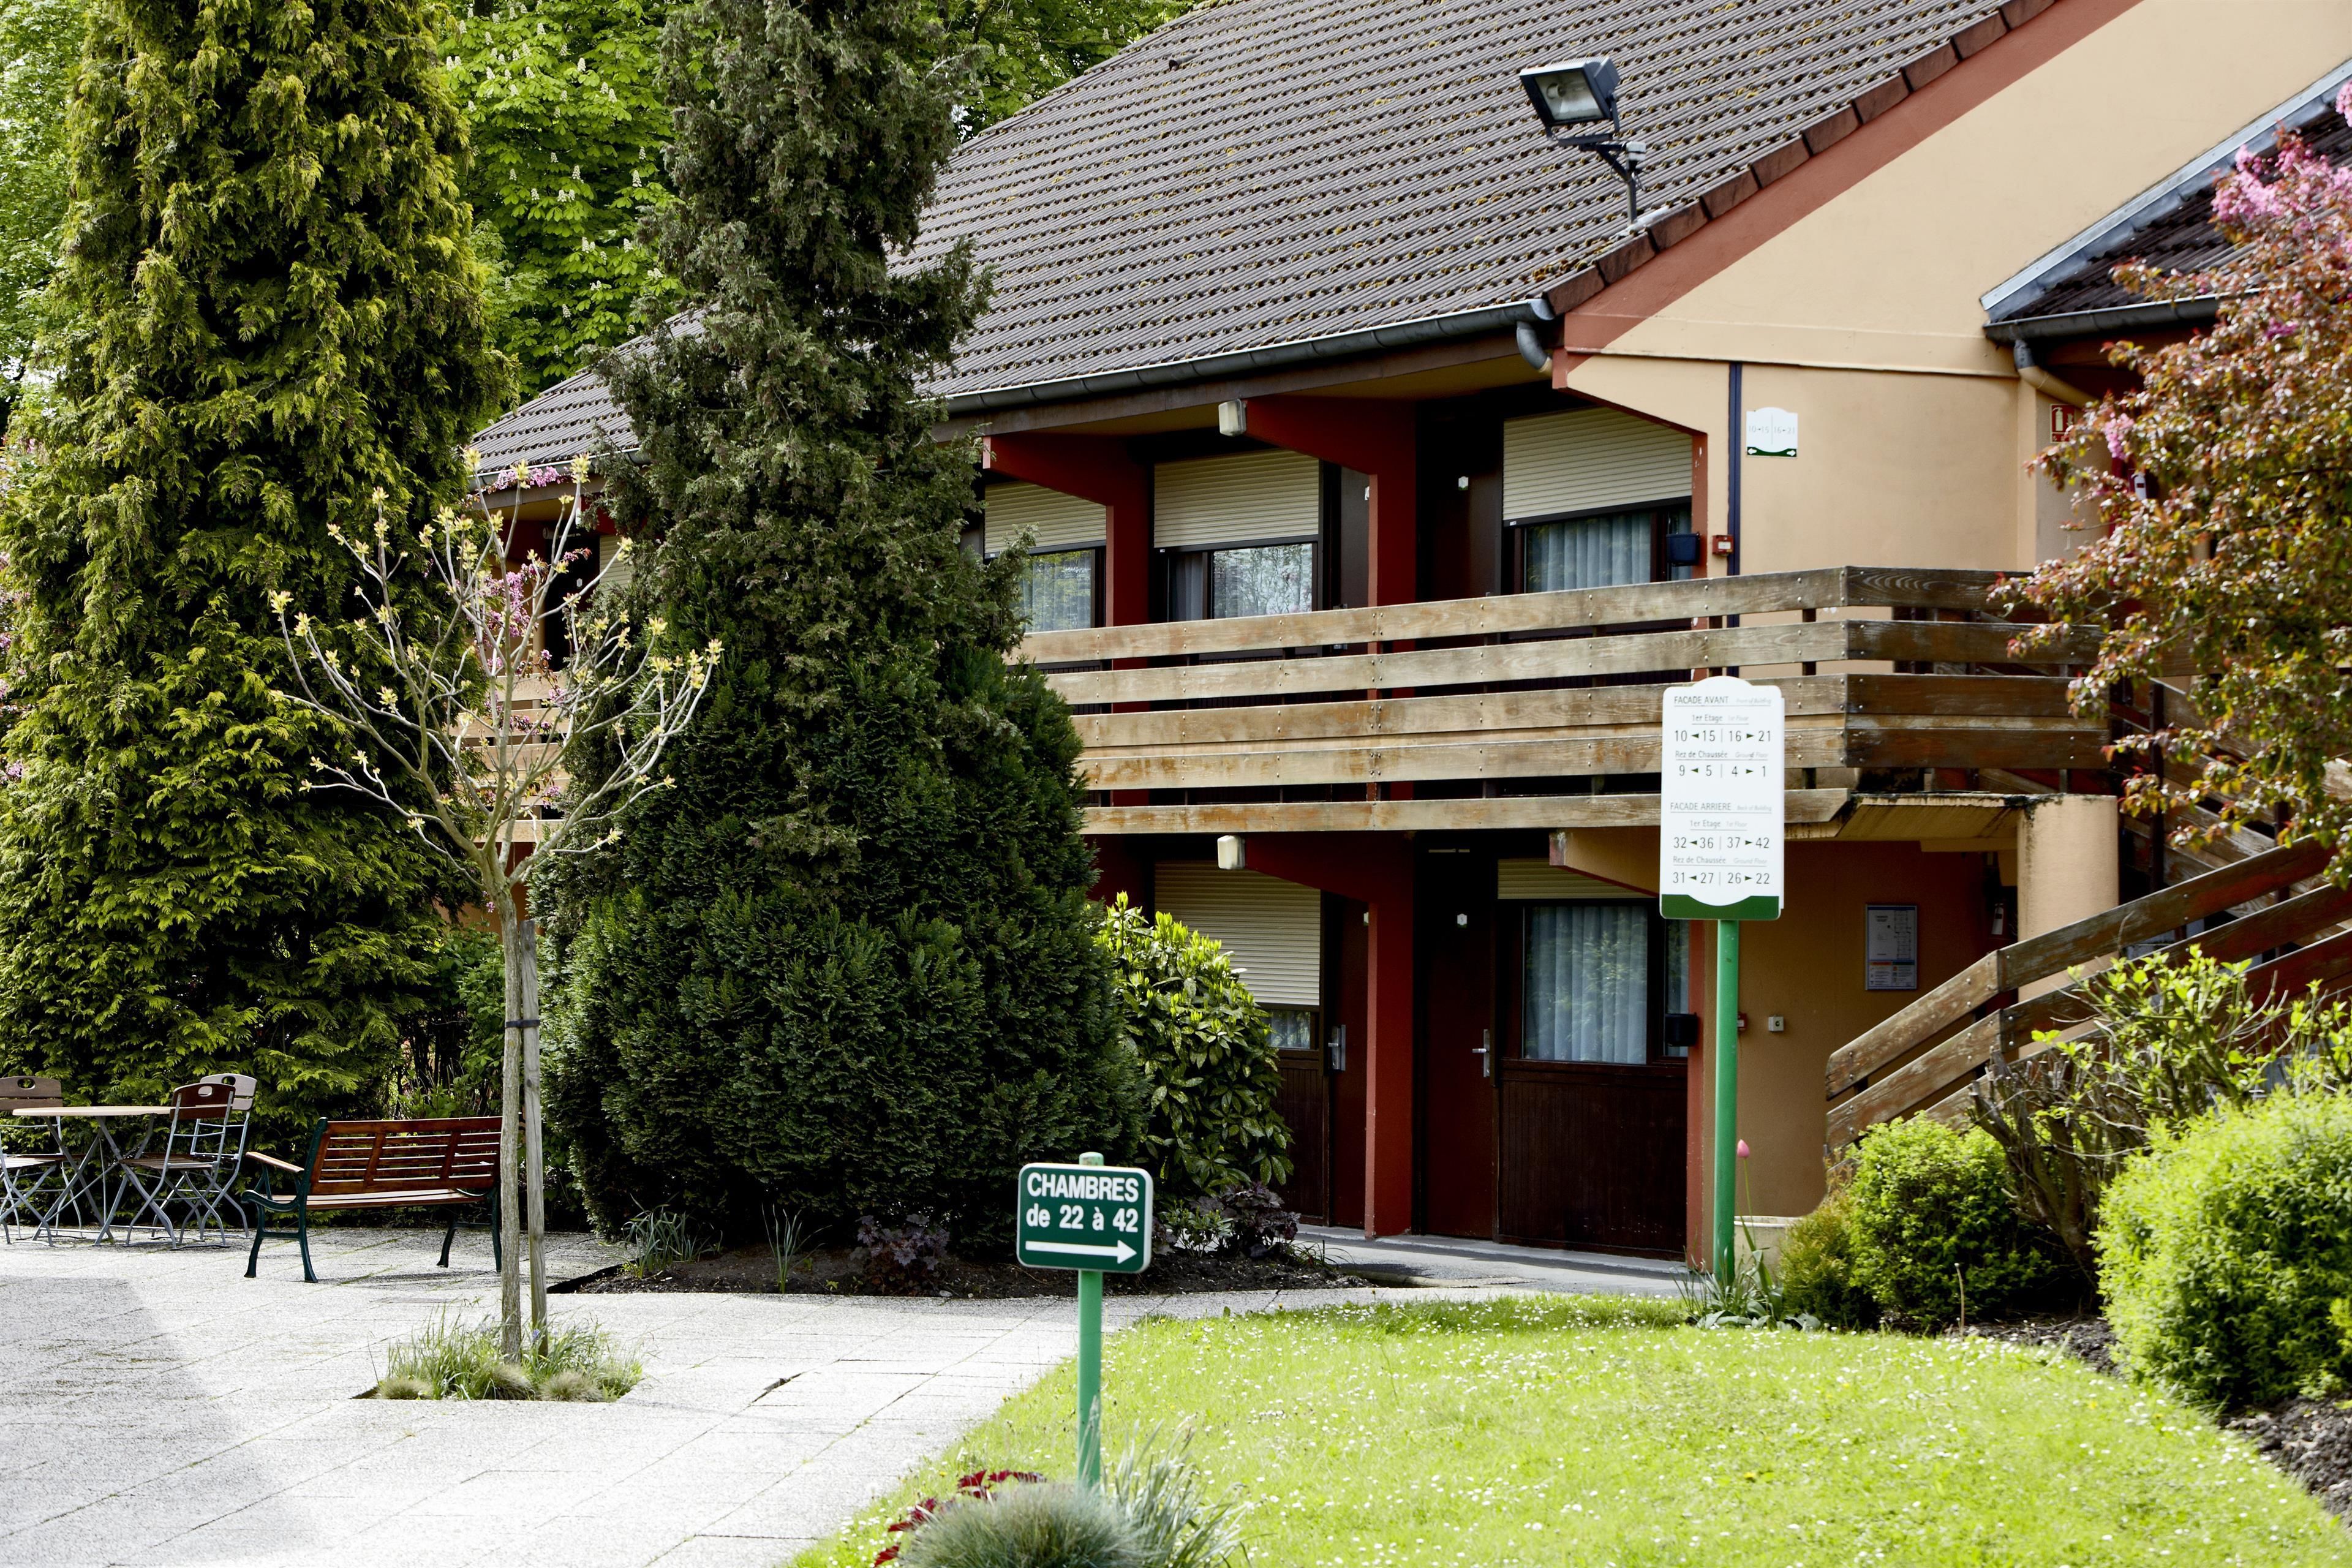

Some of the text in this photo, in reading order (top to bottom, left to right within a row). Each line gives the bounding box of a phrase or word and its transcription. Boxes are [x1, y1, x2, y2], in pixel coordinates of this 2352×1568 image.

[1705, 714, 1723, 723] Etage
[1675, 730, 1771, 742] 10 15 16 21
[1679, 764, 1766, 777] 9 5 4 1
[1702, 820, 1721, 829] Etage
[1673, 837, 1770, 849] 32 36 37 42
[1673, 872, 1770, 884] 31 27 26 22
[1027, 1172, 1139, 1202] CHAMBRES
[1026, 1203, 1138, 1233] de 22 à 42
